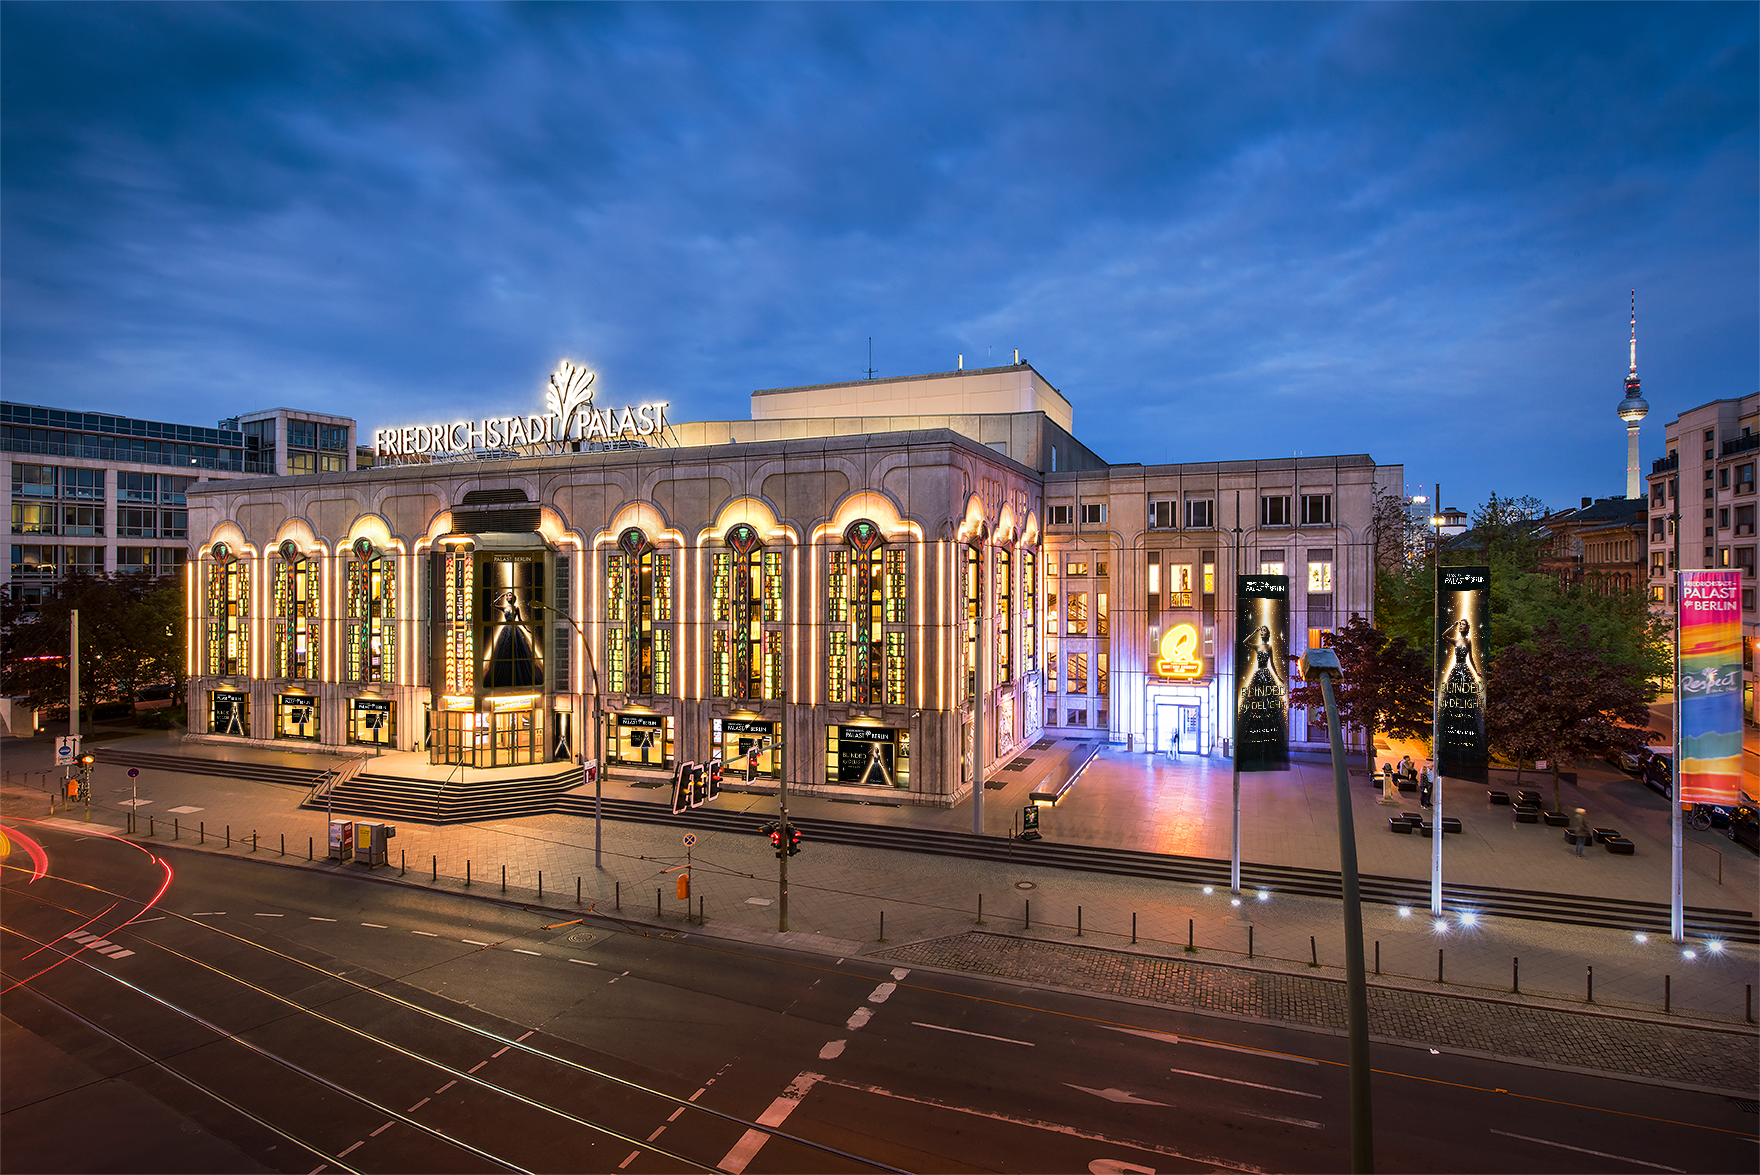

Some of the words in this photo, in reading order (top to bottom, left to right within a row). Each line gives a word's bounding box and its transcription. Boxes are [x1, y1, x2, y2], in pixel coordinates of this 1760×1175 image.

[375, 412, 557, 457] FRIEDRICHSTADT
[578, 402, 669, 441] PALAST
[1683, 587, 1737, 599] PALAST
[1694, 601, 1737, 611] BERLIN
[1240, 685, 1287, 698] BLINDED
[1440, 681, 1485, 694] BLINDED
